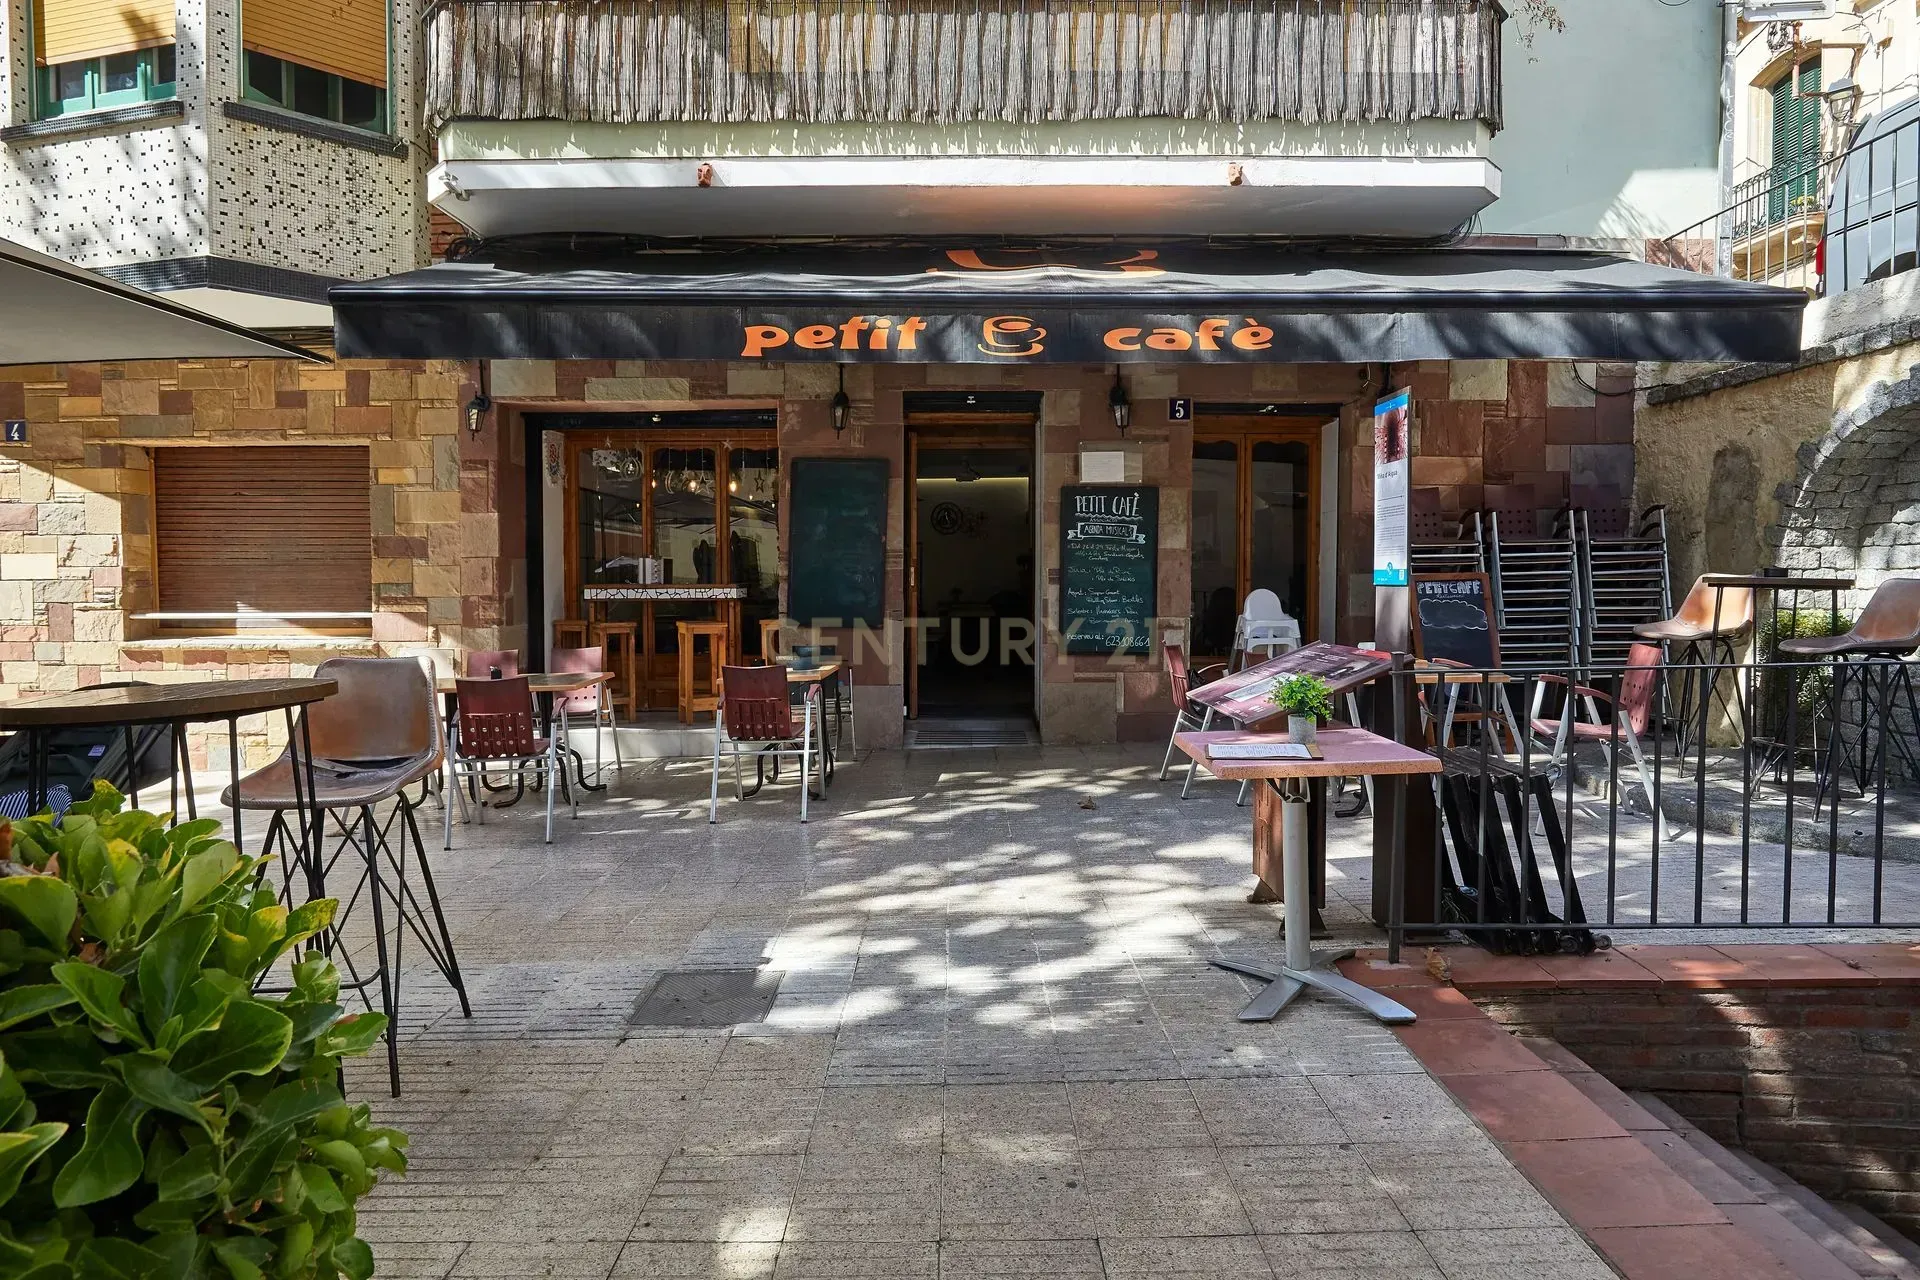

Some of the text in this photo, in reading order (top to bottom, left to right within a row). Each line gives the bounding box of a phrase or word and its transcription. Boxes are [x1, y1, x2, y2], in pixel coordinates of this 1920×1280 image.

[741, 316, 1274, 357] petit cafè
[1175, 400, 1184, 419] 5
[11, 423, 20, 441] 4
[1074, 495, 1107, 513] PETIT
